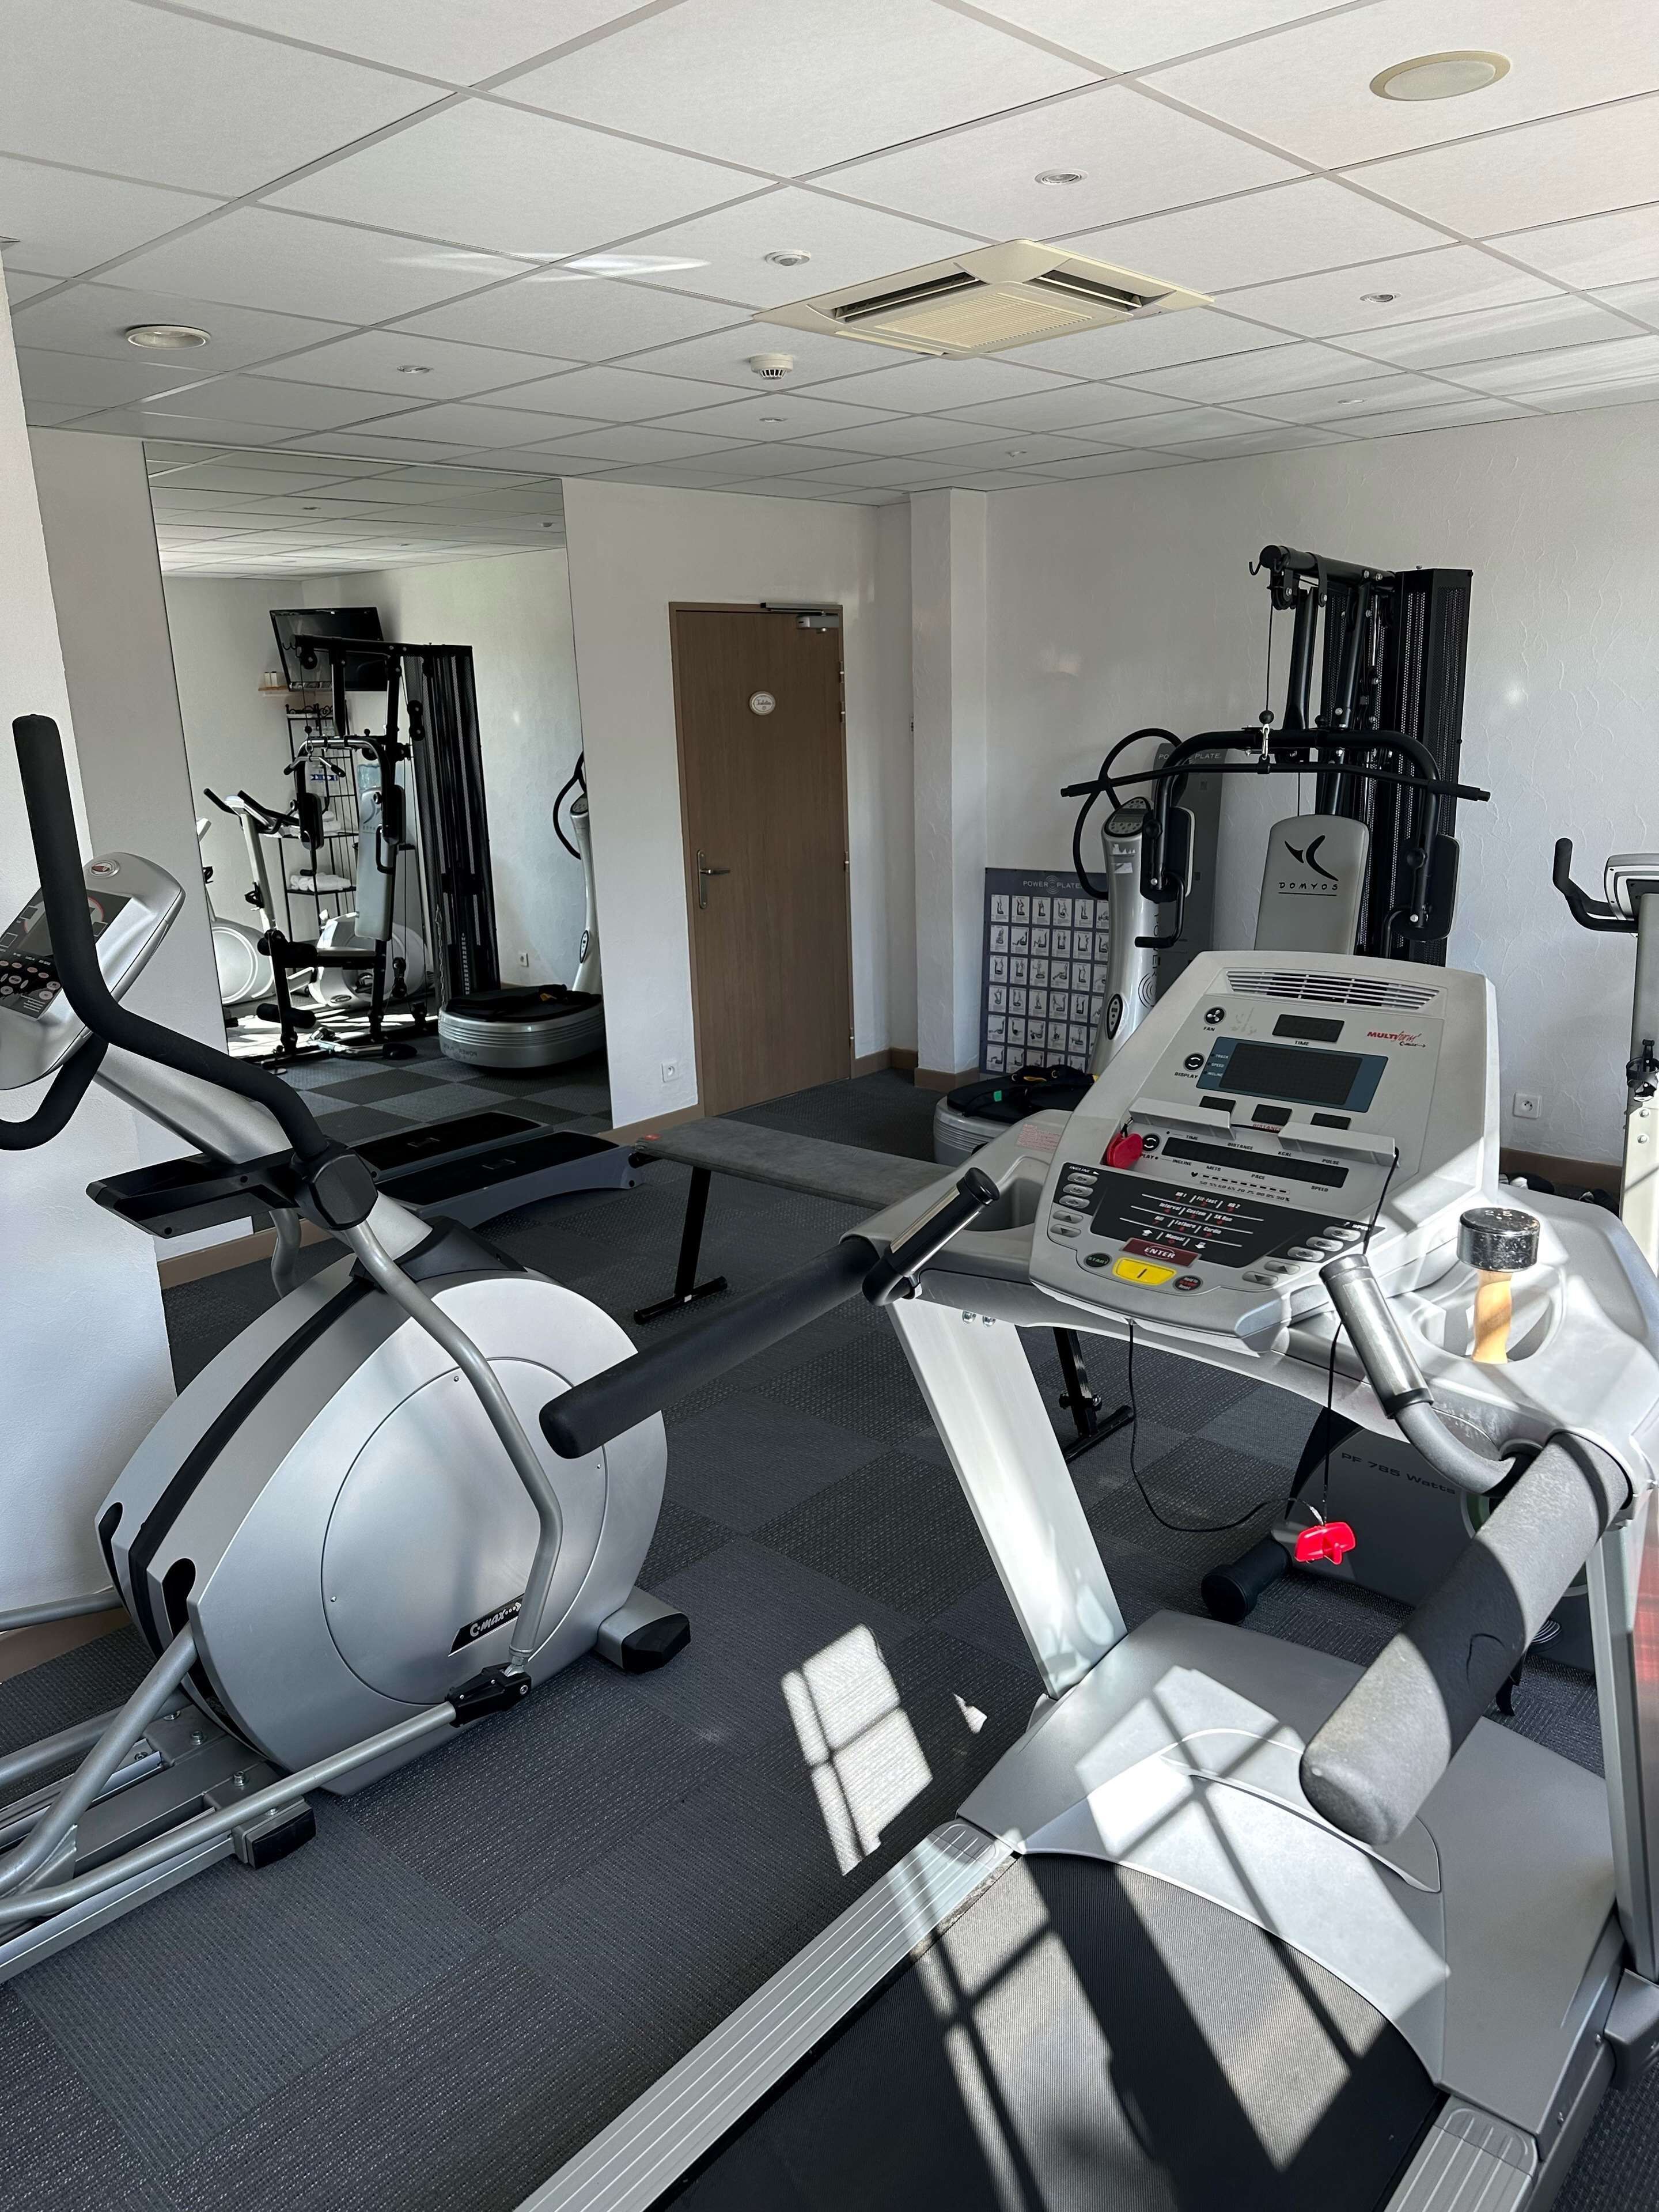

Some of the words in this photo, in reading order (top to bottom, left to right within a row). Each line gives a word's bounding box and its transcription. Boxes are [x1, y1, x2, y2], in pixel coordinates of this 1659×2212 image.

[1278, 882, 1338, 891] DOMYOS
[1227, 1142, 1253, 1151] DISTANCE
[1144, 1247, 1176, 1259] ENTER
[1087, 1256, 1109, 1265] START
[1341, 1452, 1362, 1463] PF
[1367, 1461, 1401, 1477] 785
[1406, 1473, 1456, 1495] Watts
